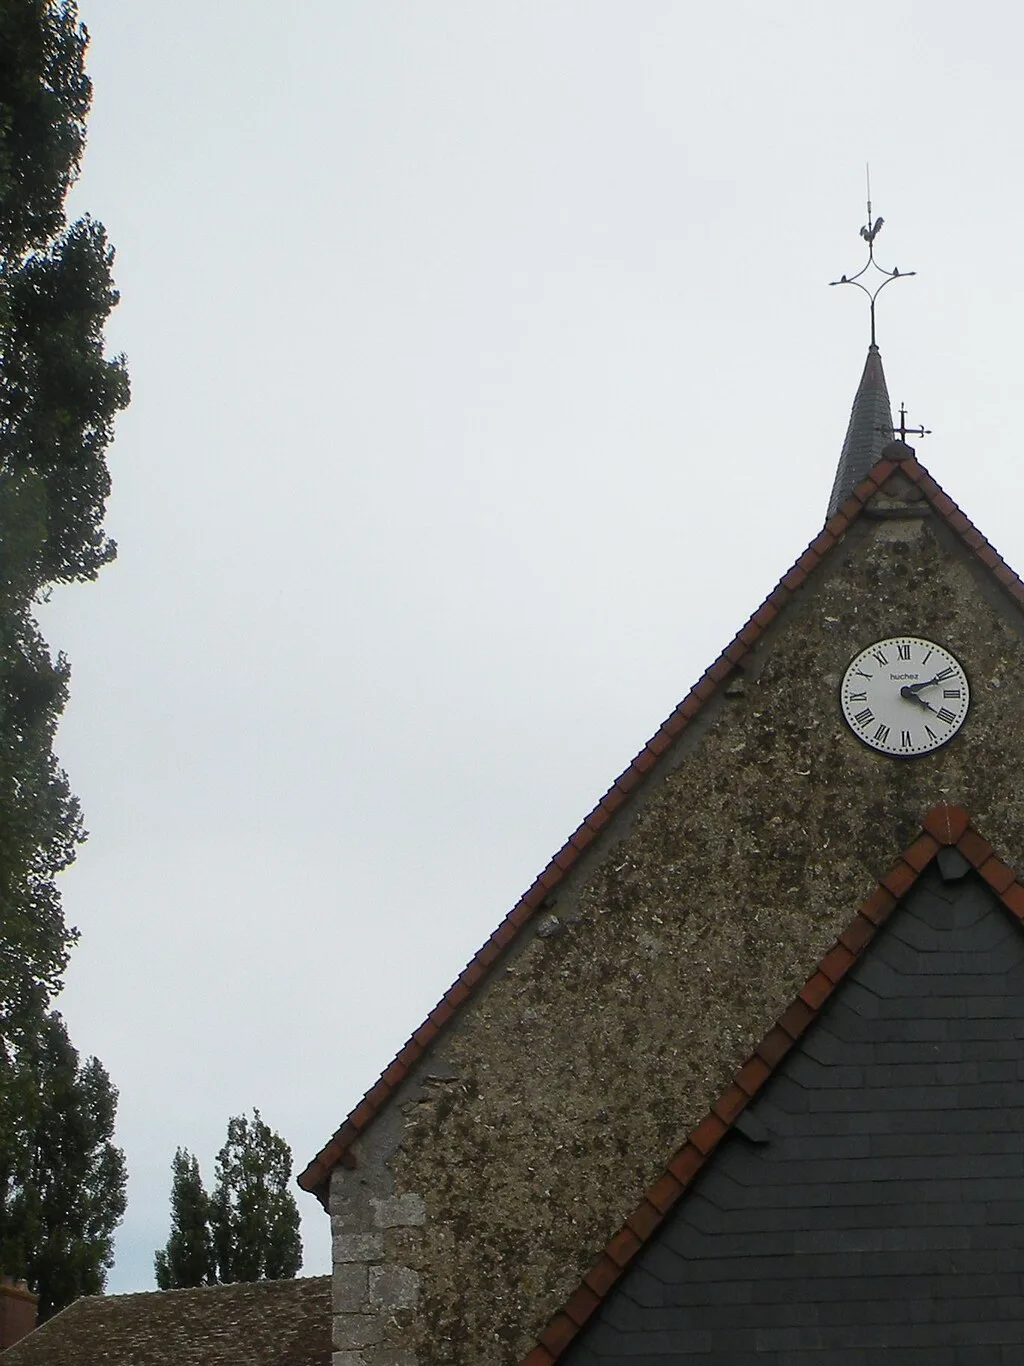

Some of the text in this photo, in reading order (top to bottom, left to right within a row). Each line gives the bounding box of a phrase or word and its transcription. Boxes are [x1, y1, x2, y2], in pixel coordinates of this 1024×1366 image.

[873, 651, 888, 667] XI
[897, 645, 911, 660] XII
[923, 651, 932, 664] I
[856, 669, 873, 681] X
[936, 666, 953, 678] II
[850, 692, 867, 701] IX
[944, 690, 960, 698] III
[855, 708, 875, 728] VIII
[937, 707, 956, 724] IIII
[873, 725, 890, 743] VII
[901, 731, 912, 747] VI
[925, 725, 937, 741] V
